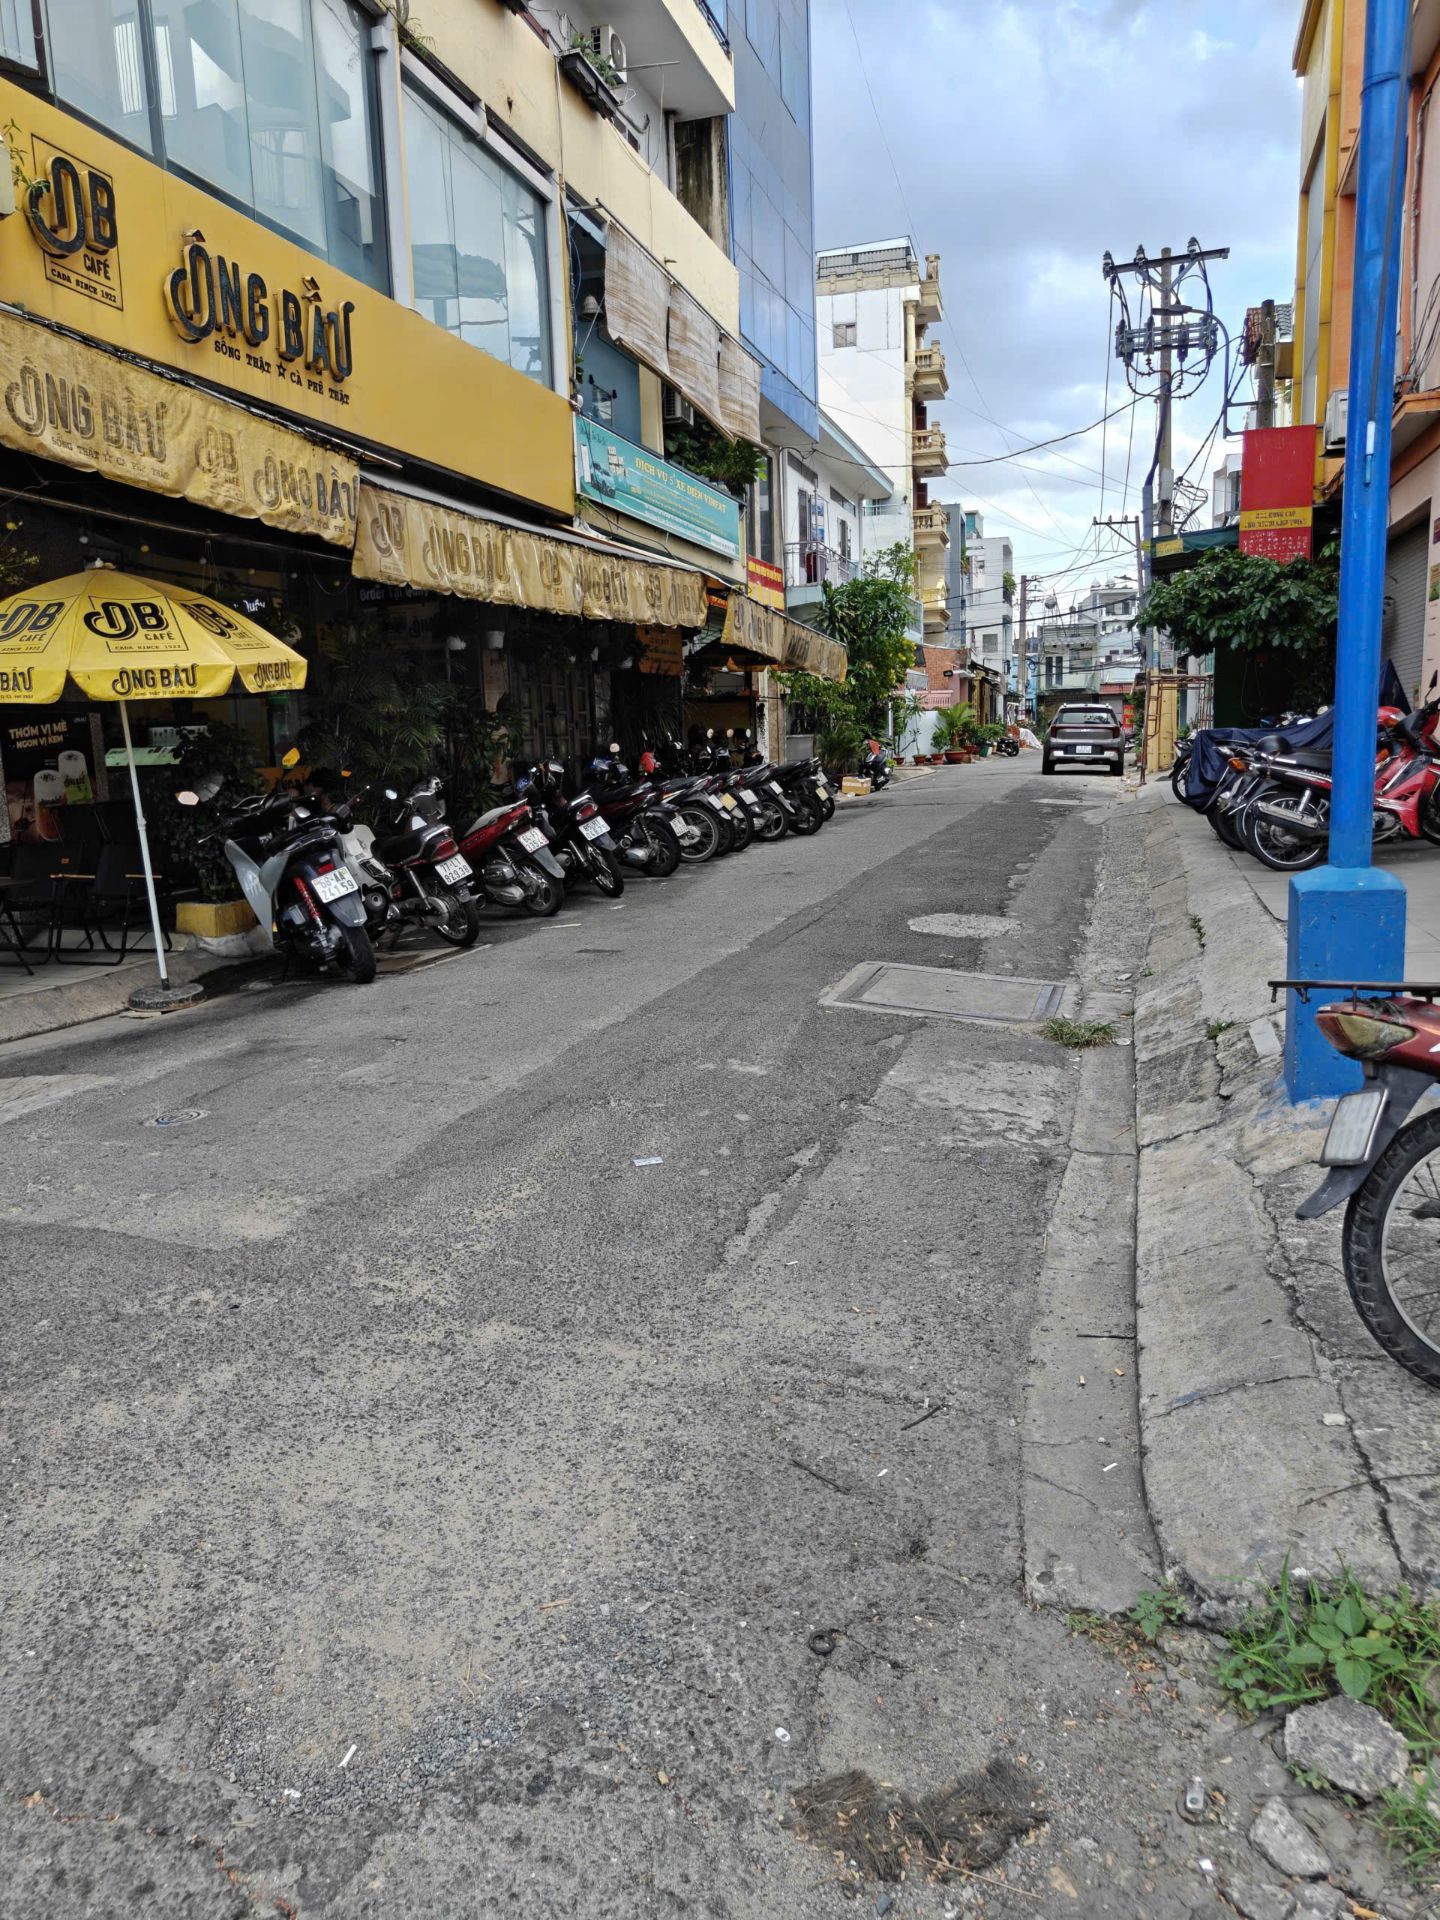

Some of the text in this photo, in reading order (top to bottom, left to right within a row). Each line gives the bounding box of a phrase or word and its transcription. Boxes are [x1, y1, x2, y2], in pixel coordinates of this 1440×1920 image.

[83, 253, 111, 281] CAFÉ
[51, 268, 117, 303] CADA SINCE 1922
[164, 229, 269, 345] ÔNG
[214, 336, 350, 406] SỐNG THẬT CÀ PHÊ THẬT
[5, 356, 95, 439] ÔNG
[83, 602, 169, 641] OB
[144, 631, 175, 641] CAFÉ
[19, 633, 47, 642] CAFÉ
[112, 666, 157, 696] ÔNG
[8, 723, 39, 740] THƠM
[41, 723, 51, 737] VỊ
[16, 735, 64, 749] NGON VỊ KEM
